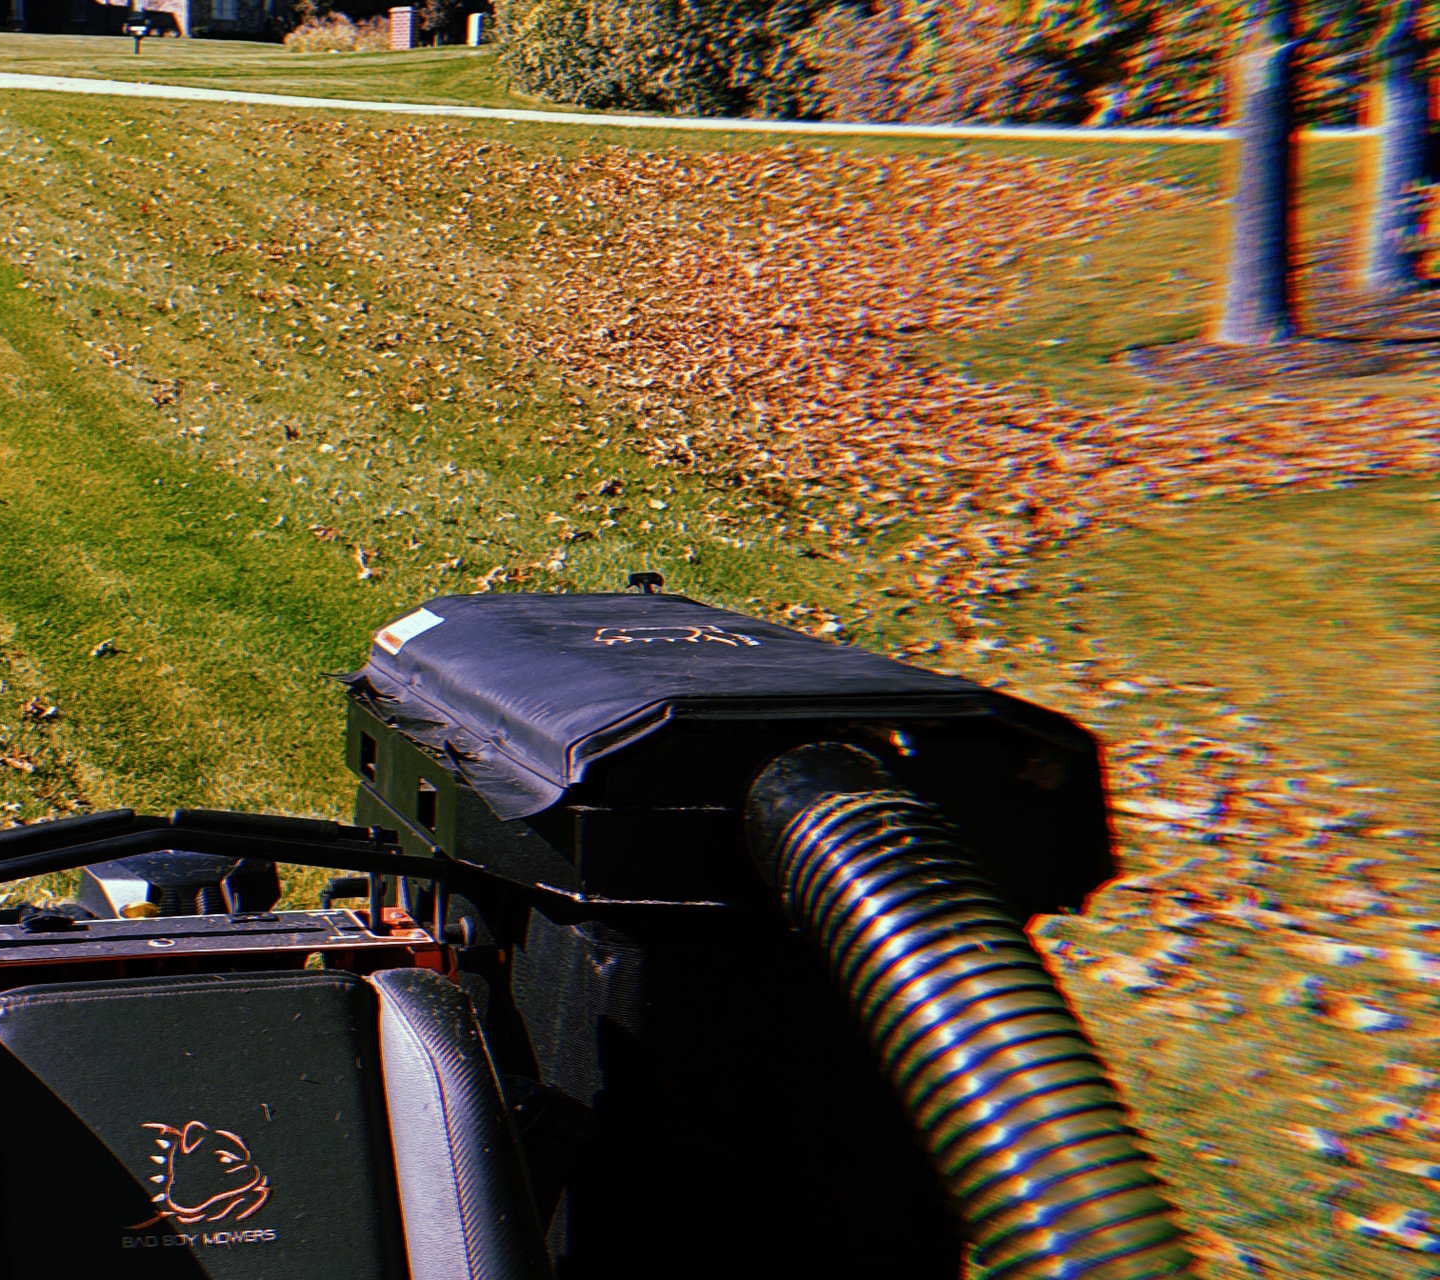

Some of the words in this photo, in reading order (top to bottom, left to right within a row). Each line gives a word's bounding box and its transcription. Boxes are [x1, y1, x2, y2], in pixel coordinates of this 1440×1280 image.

[121, 1234, 158, 1249] BAD
[162, 1233, 199, 1248] BOY
[202, 1228, 279, 1247] MOWERS
